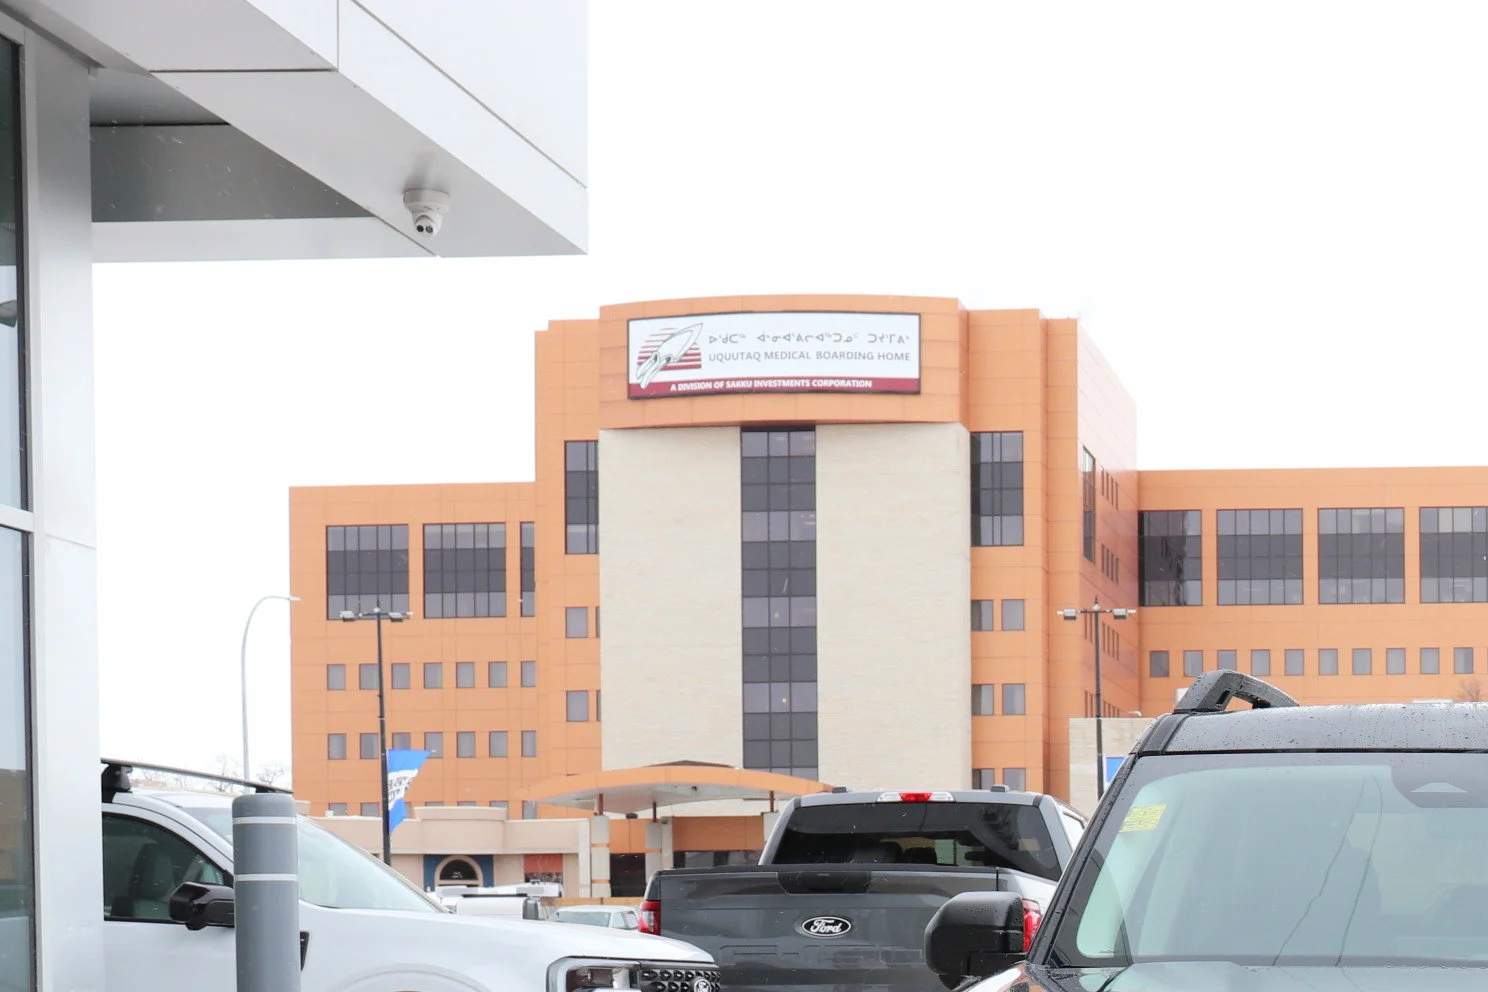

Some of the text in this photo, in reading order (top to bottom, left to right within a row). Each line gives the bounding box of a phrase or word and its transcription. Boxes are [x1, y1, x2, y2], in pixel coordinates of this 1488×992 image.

[709, 350, 910, 363] UQUUTAQ MEDICAL BOARDING HOME
[670, 379, 872, 392] A DIVISION OF SAKKU INVESTMENTS CORPORATION
[809, 919, 842, 933] Ford
